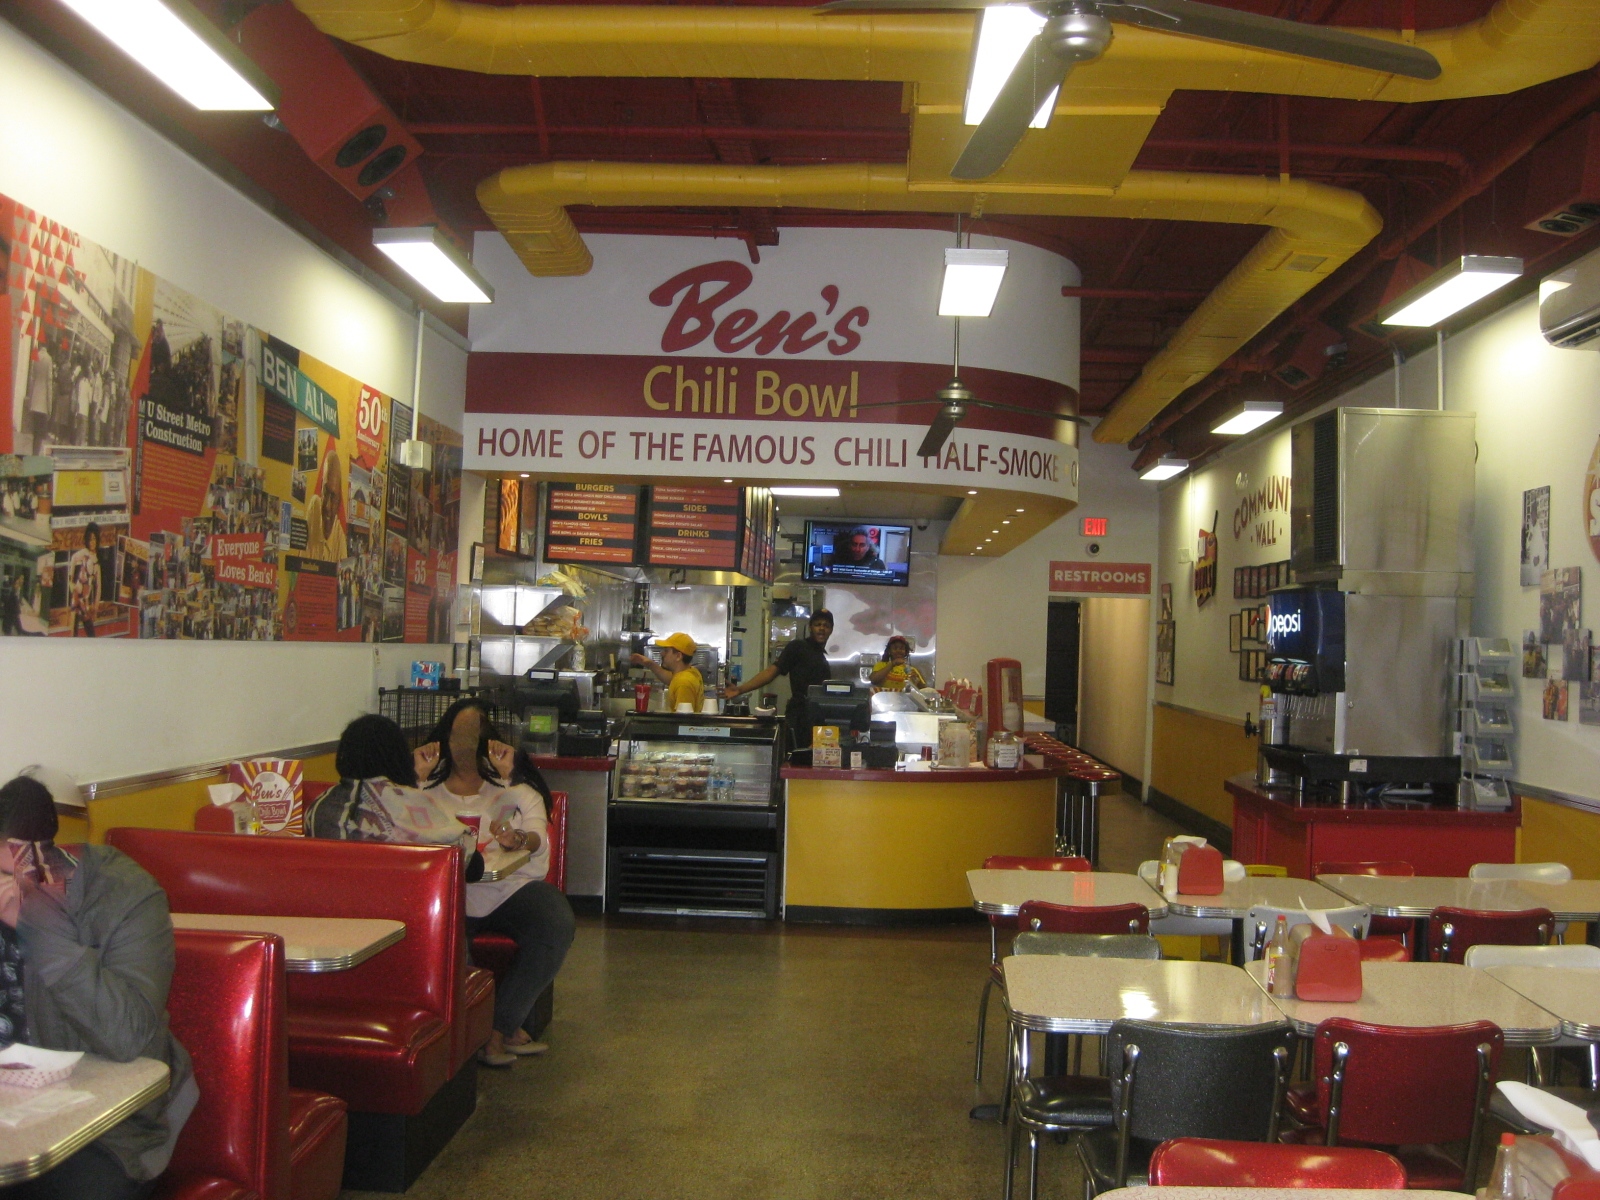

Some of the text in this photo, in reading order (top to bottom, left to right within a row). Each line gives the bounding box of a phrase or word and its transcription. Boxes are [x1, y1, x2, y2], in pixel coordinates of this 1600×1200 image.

[649, 260, 869, 355] Ben's
[264, 347, 297, 403] BEN
[305, 381, 324, 423] ALI
[324, 403, 336, 425] WAY
[643, 365, 738, 414] Chili
[147, 400, 211, 436] U Street Metro
[146, 421, 203, 452] Construction
[478, 428, 563, 458] HOME
[578, 430, 616, 459] OF
[629, 432, 684, 461] THE
[693, 433, 815, 465] FAMOUS
[834, 437, 907, 467] CHILI
[575, 483, 615, 492] BURGERS
[578, 513, 608, 521] BOWLS
[683, 504, 707, 512] SIDES
[1233, 475, 1291, 539] COMMUNI
[677, 529, 710, 537] DRINKS
[1084, 517, 1107, 536] EXIT
[1255, 520, 1276, 544] WALL
[217, 539, 260, 559] Everyone
[579, 538, 603, 546] FRIES
[219, 560, 273, 585] Loves Ben's!
[415, 559, 426, 585] 55
[1054, 570, 1146, 583] RESTROOMS
[1272, 608, 1301, 638] pepsi
[252, 782, 282, 800] Ben's
